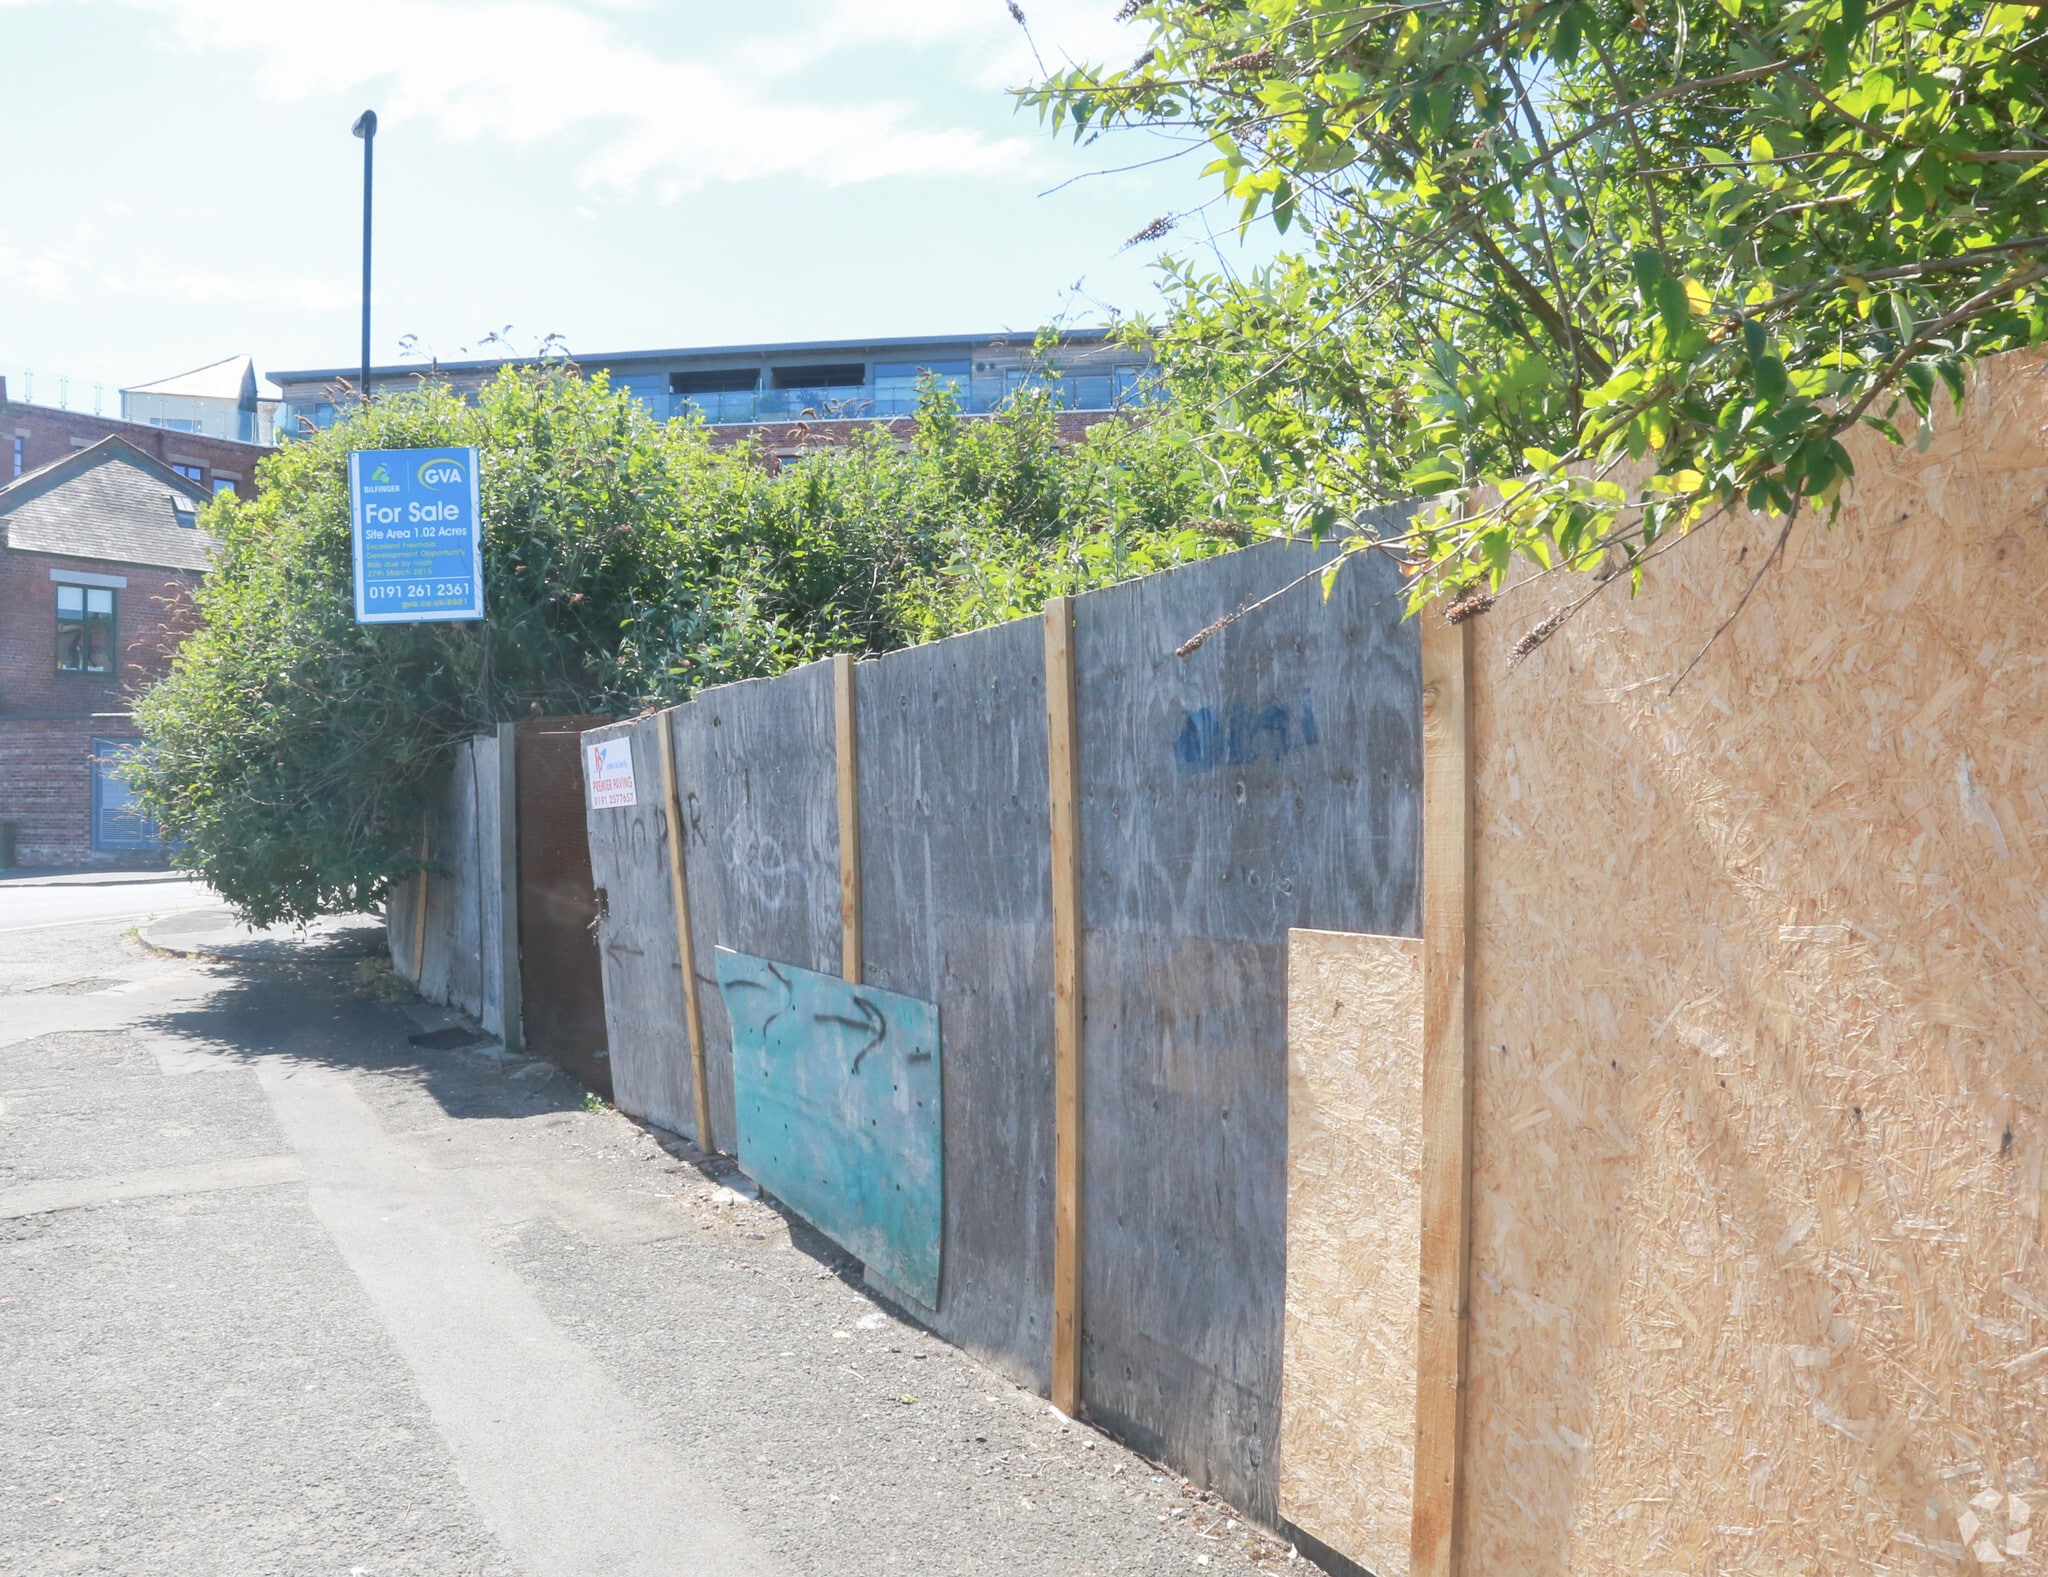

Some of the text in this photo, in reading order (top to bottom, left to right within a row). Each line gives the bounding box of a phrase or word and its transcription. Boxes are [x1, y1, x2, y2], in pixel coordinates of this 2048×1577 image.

[424, 468, 463, 485] GVA
[365, 500, 460, 524] For Sale
[365, 526, 468, 540] Site Area 1.02 Acres
[367, 548, 465, 560] Development Opportunity
[369, 582, 470, 599] 0191 261 2361
[592, 775, 633, 793] PREMIER PAVING
[593, 792, 634, 806] 0191 2577657
